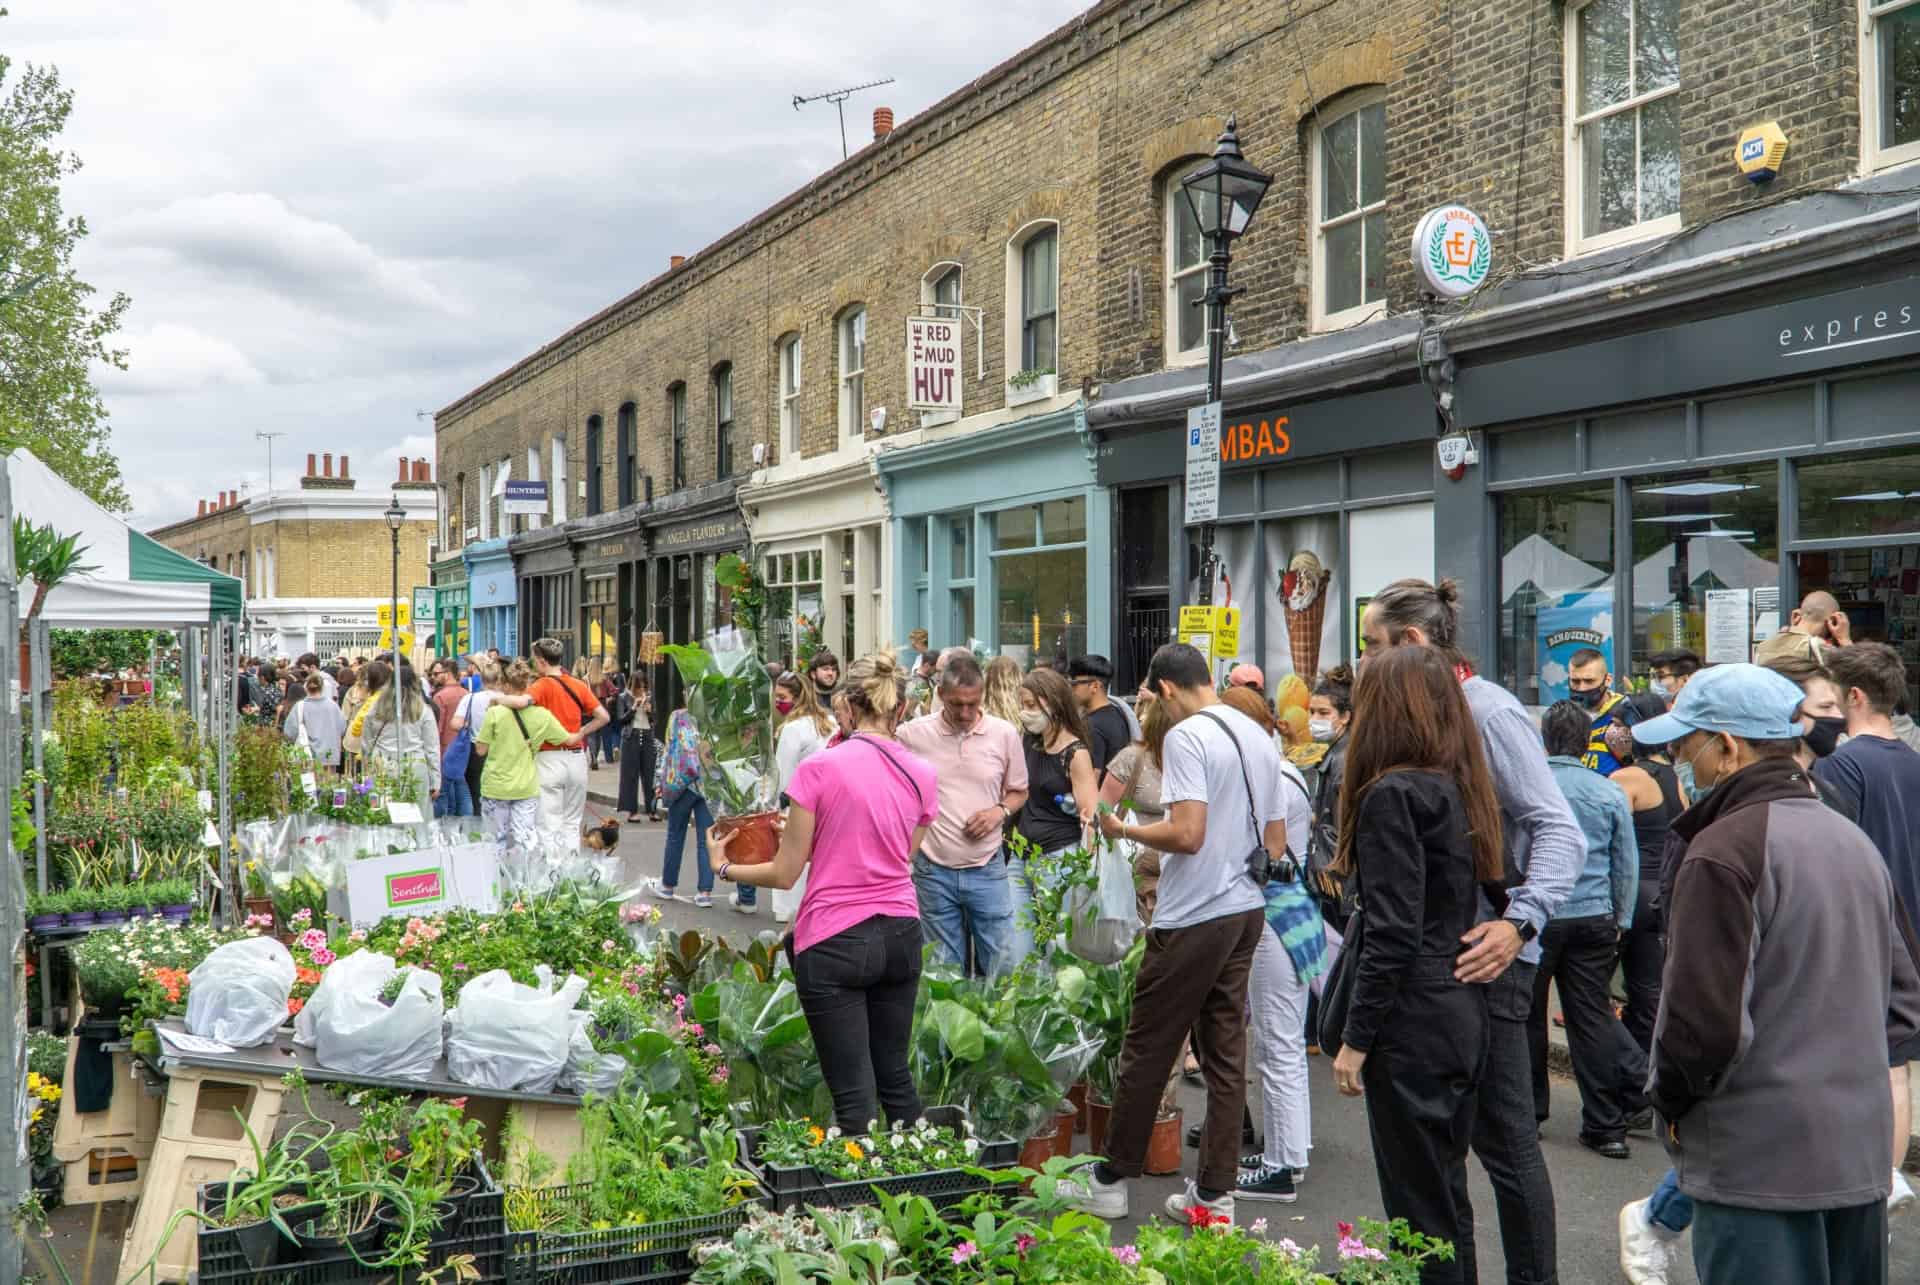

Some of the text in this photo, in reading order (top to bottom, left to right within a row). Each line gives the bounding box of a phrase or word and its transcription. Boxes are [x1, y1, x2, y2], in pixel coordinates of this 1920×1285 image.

[1744, 141, 1761, 157] ADT
[927, 325, 951, 342] RED
[912, 324, 922, 362] THE
[924, 347, 955, 363] MUD
[914, 367, 955, 403] HUT
[1220, 416, 1291, 462] MBAS
[381, 610, 405, 620] ET
